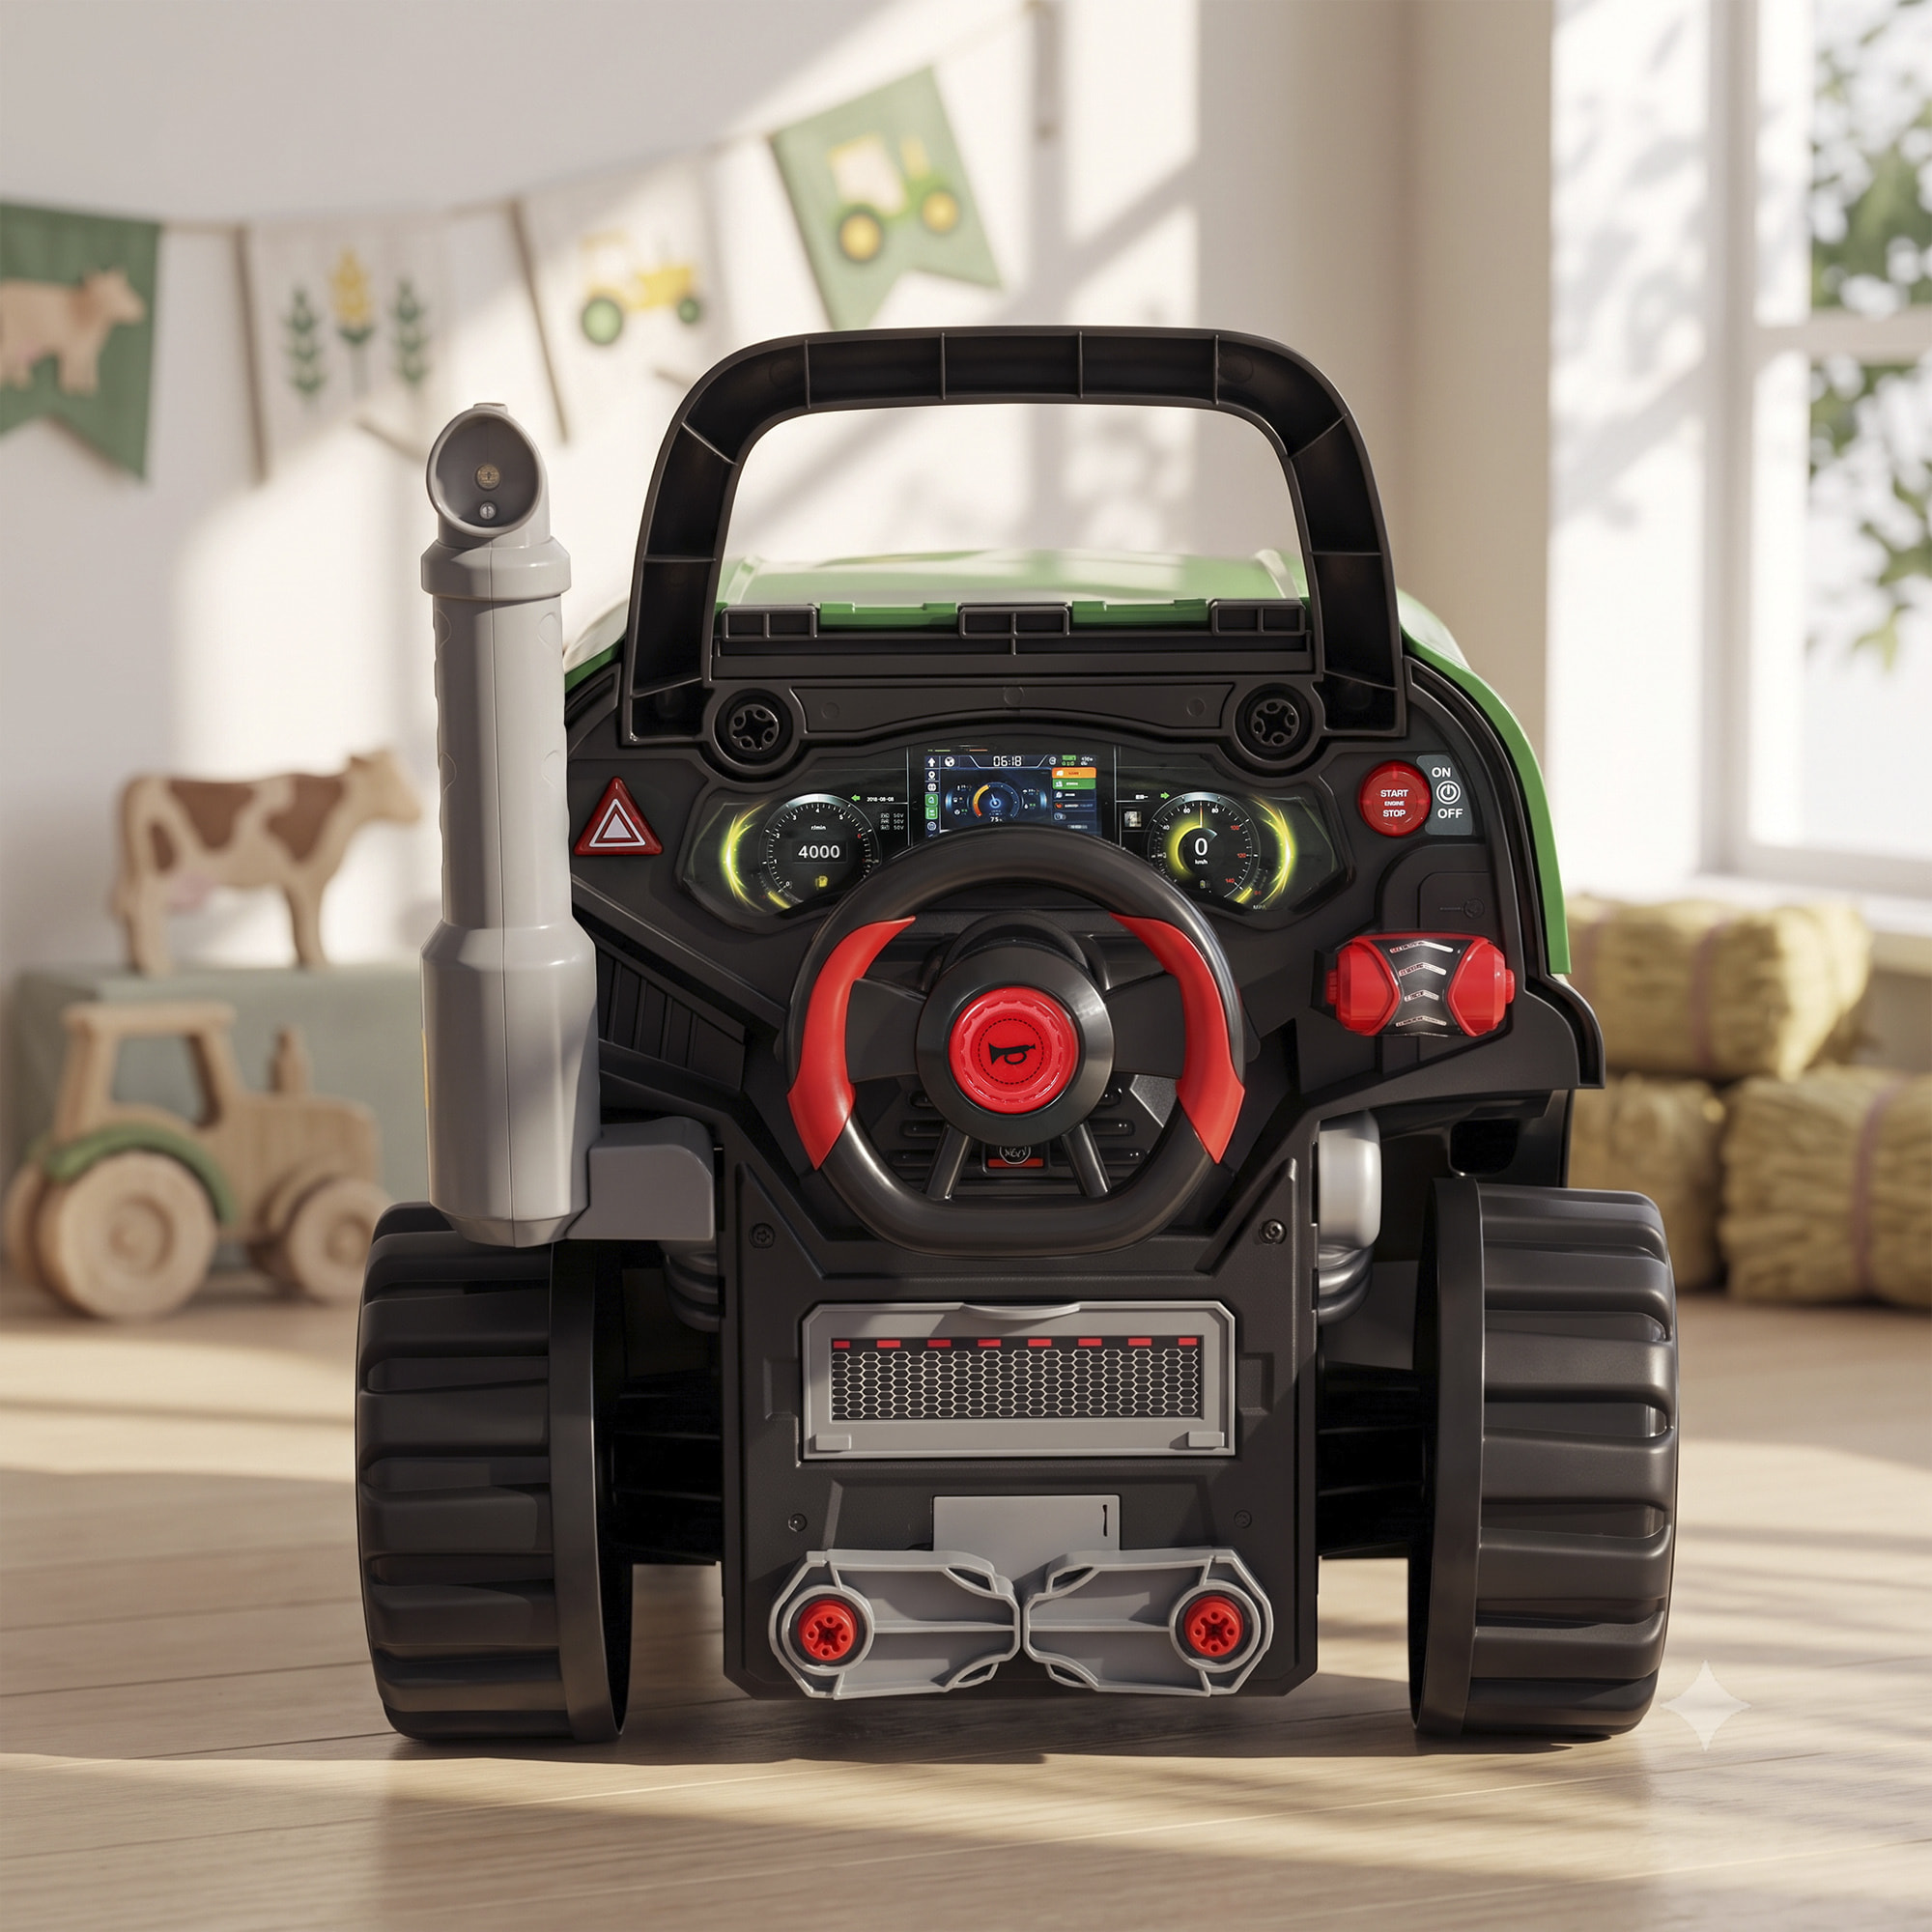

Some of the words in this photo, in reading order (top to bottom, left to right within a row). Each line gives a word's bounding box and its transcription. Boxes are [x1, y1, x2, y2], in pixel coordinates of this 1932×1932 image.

[993, 755, 1022, 767] 06:18
[1432, 767, 1451, 778] ON
[1437, 809, 1463, 818] OFF
[798, 844, 840, 859] 4000
[1194, 838, 1208, 856] 0
